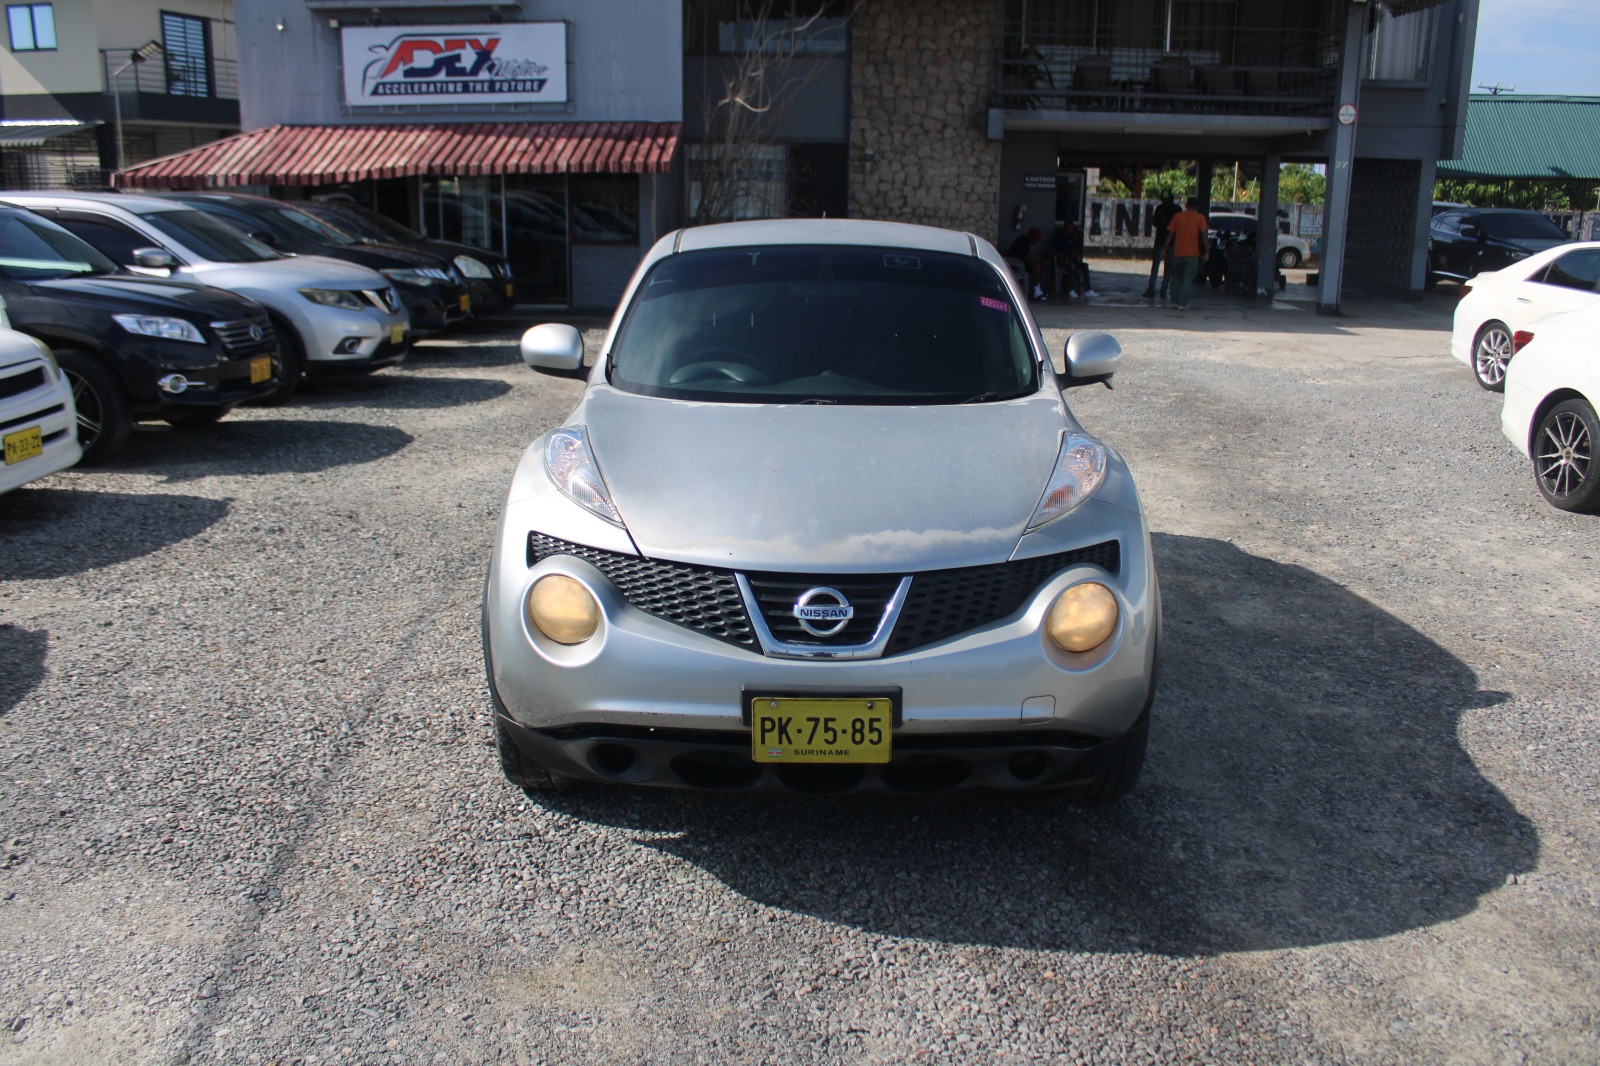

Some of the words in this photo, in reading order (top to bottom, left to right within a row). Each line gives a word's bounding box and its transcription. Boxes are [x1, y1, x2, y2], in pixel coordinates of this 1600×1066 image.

[381, 38, 501, 79] ADEX
[377, 81, 463, 94] ACCELERATING
[469, 81, 490, 93] THE
[495, 80, 540, 93] FUTURE
[1335, 160, 1349, 169] 27
[800, 608, 848, 618] NISSAN
[793, 749, 850, 757] SURINAME
